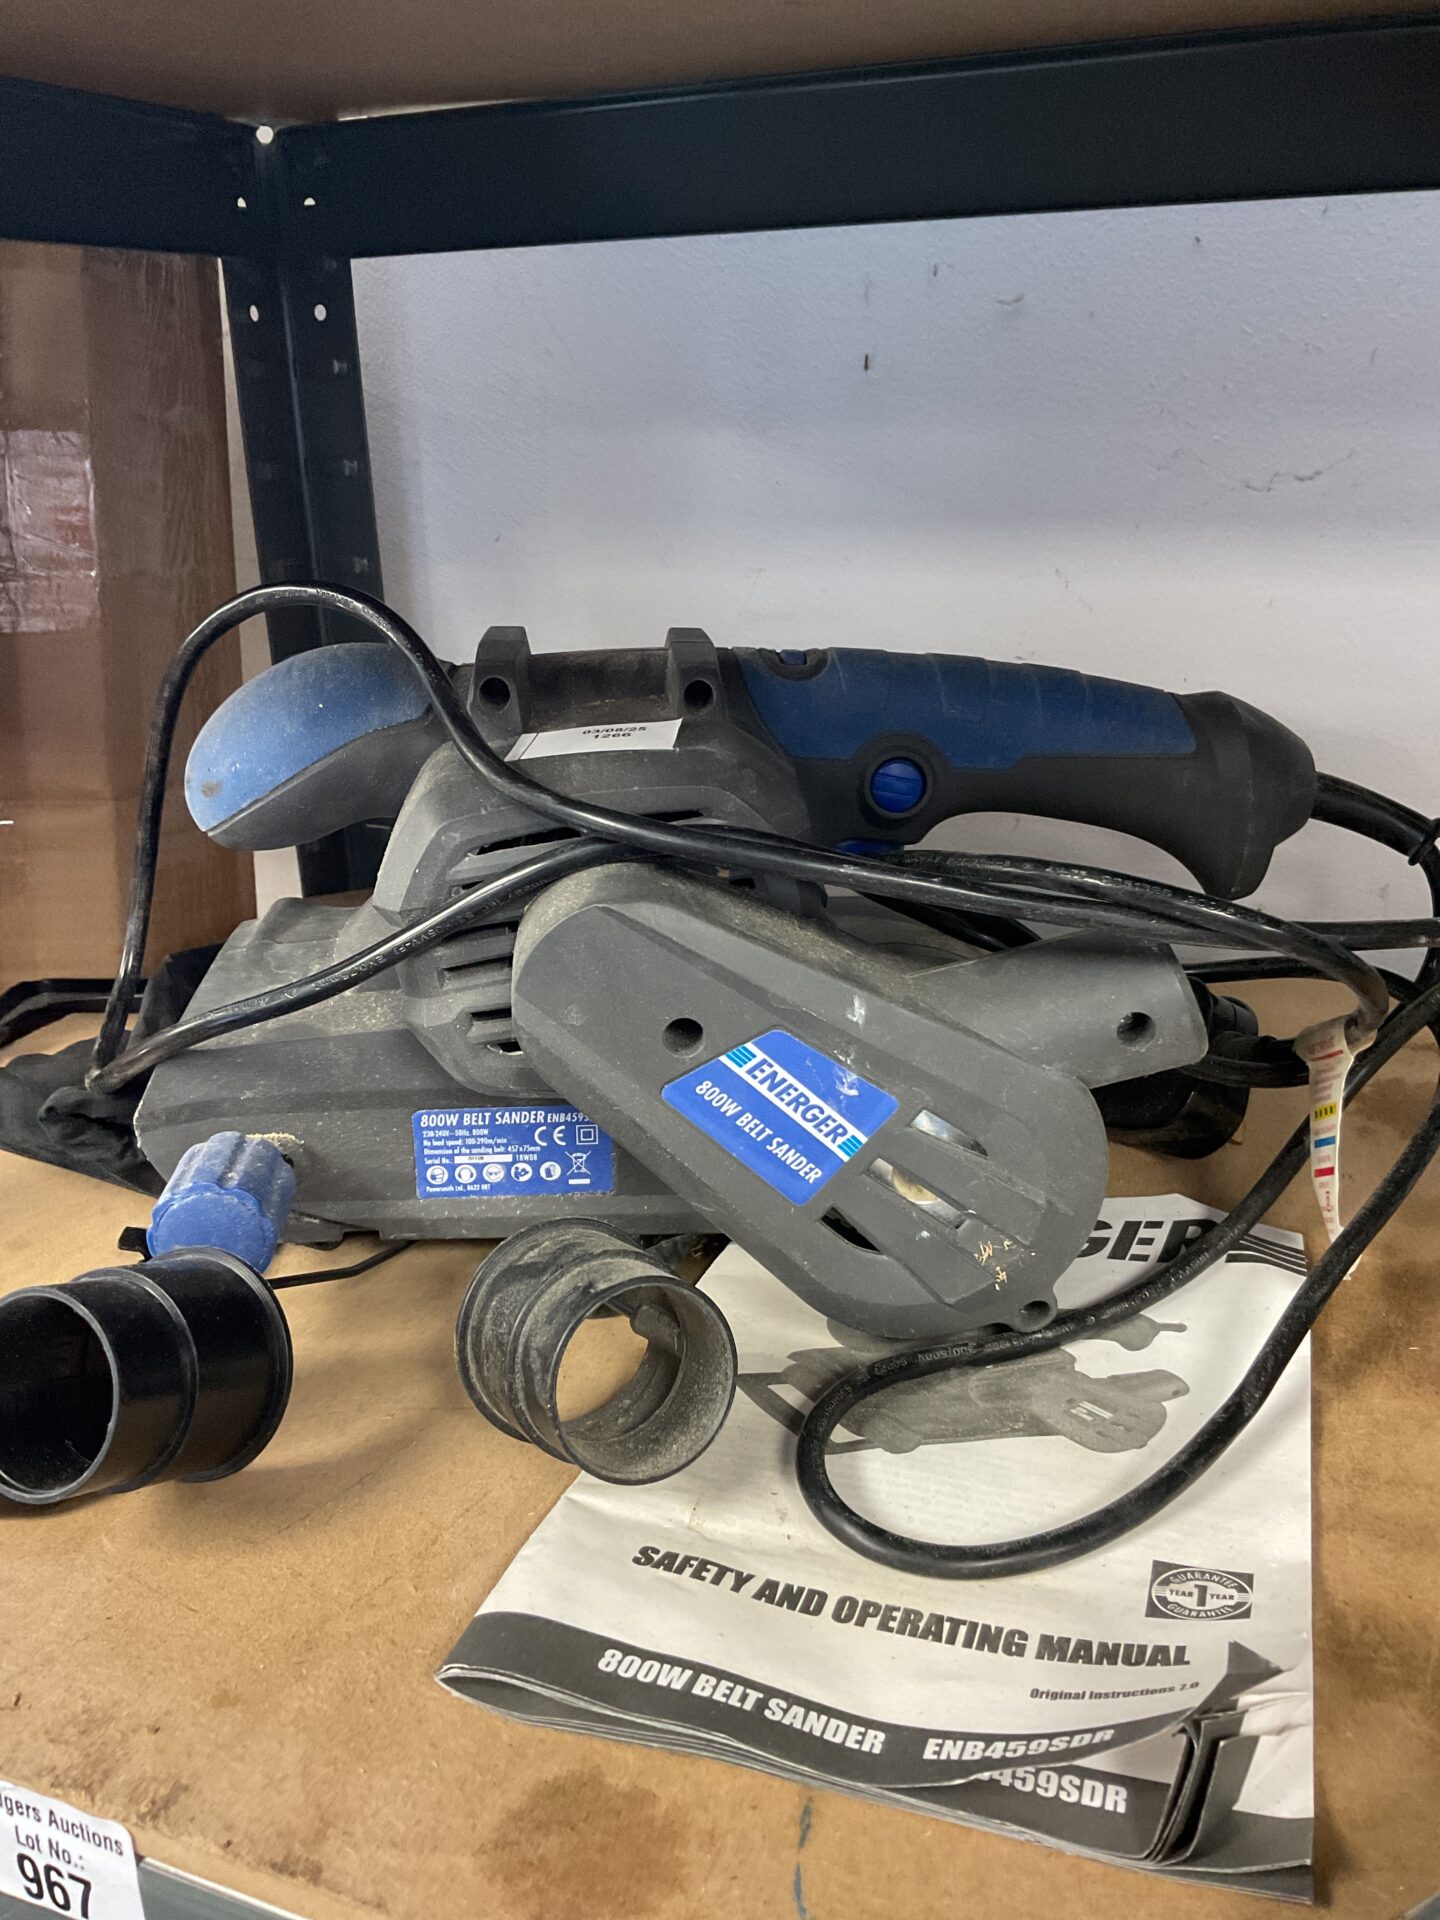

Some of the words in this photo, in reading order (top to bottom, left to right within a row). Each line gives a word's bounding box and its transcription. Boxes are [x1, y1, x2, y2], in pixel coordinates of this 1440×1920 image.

[745, 1057, 849, 1145] ENERGER
[420, 1113, 459, 1128] 800W
[463, 1112, 492, 1126] BELT
[494, 1110, 545, 1125] SANDER
[547, 1112, 593, 1123] ENB459S
[695, 1080, 743, 1118] 800W
[735, 1113, 774, 1142] BELT
[766, 1137, 823, 1185] SANDER
[423, 1139, 431, 1147] No
[432, 1138, 445, 1147] load
[424, 1156, 439, 1165] Serial
[1169, 1571, 1239, 1588] GUARANTEE
[631, 1545, 757, 1594] SAFETY
[750, 1578, 829, 1617] AND
[831, 1595, 1029, 1658] OPERATING
[1035, 1633, 1191, 1667] MANUAL
[1167, 1603, 1234, 1618] GUARANTEE
[1169, 1589, 1194, 1598] YEAR
[1194, 1584, 1208, 1607] 1
[598, 1648, 694, 1691] 800W
[691, 1673, 764, 1712] BELT
[763, 1697, 887, 1755] SANDER
[922, 1729, 1115, 1761] ENB459SDR
[1029, 1687, 1086, 1701] Original
[1088, 1685, 1176, 1700] Instructions
[975, 1766, 1129, 1814] 459SDR
[15, 1824, 42, 1854] Lot
[48, 1809, 124, 1856] Auctions
[16, 1852, 92, 1920] 967
